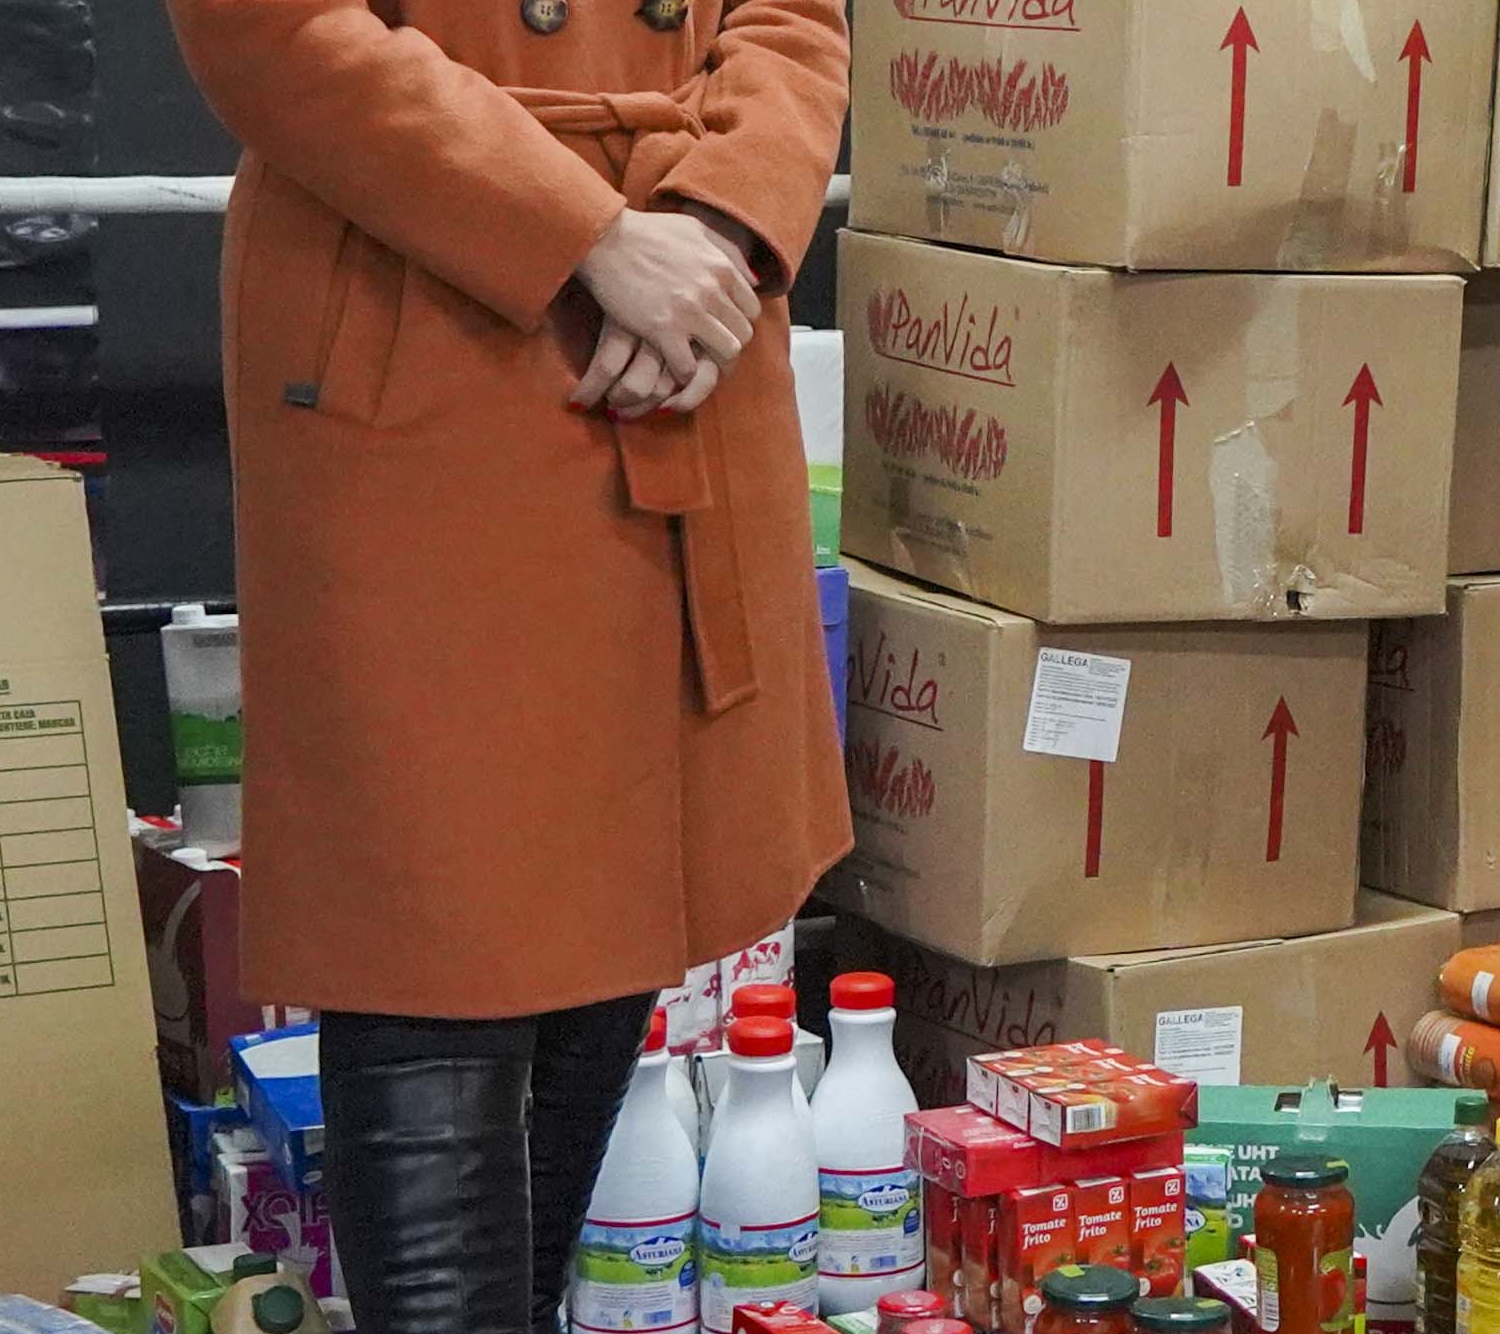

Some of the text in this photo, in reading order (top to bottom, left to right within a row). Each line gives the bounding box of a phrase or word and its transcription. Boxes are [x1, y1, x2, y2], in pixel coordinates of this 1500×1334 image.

[889, 288, 1014, 383] PanVida
[1041, 653, 1088, 667] GALLEGA
[1158, 1014, 1203, 1025] GALLEGA
[1238, 1145, 1280, 1160] UHT
[1079, 1209, 1122, 1227] Tomate
[1134, 1202, 1178, 1219] Tomate
[1022, 1217, 1066, 1235] Tomate
[1134, 1214, 1162, 1232] frito
[1022, 1232, 1051, 1250] frito
[1079, 1224, 1108, 1243] frito
